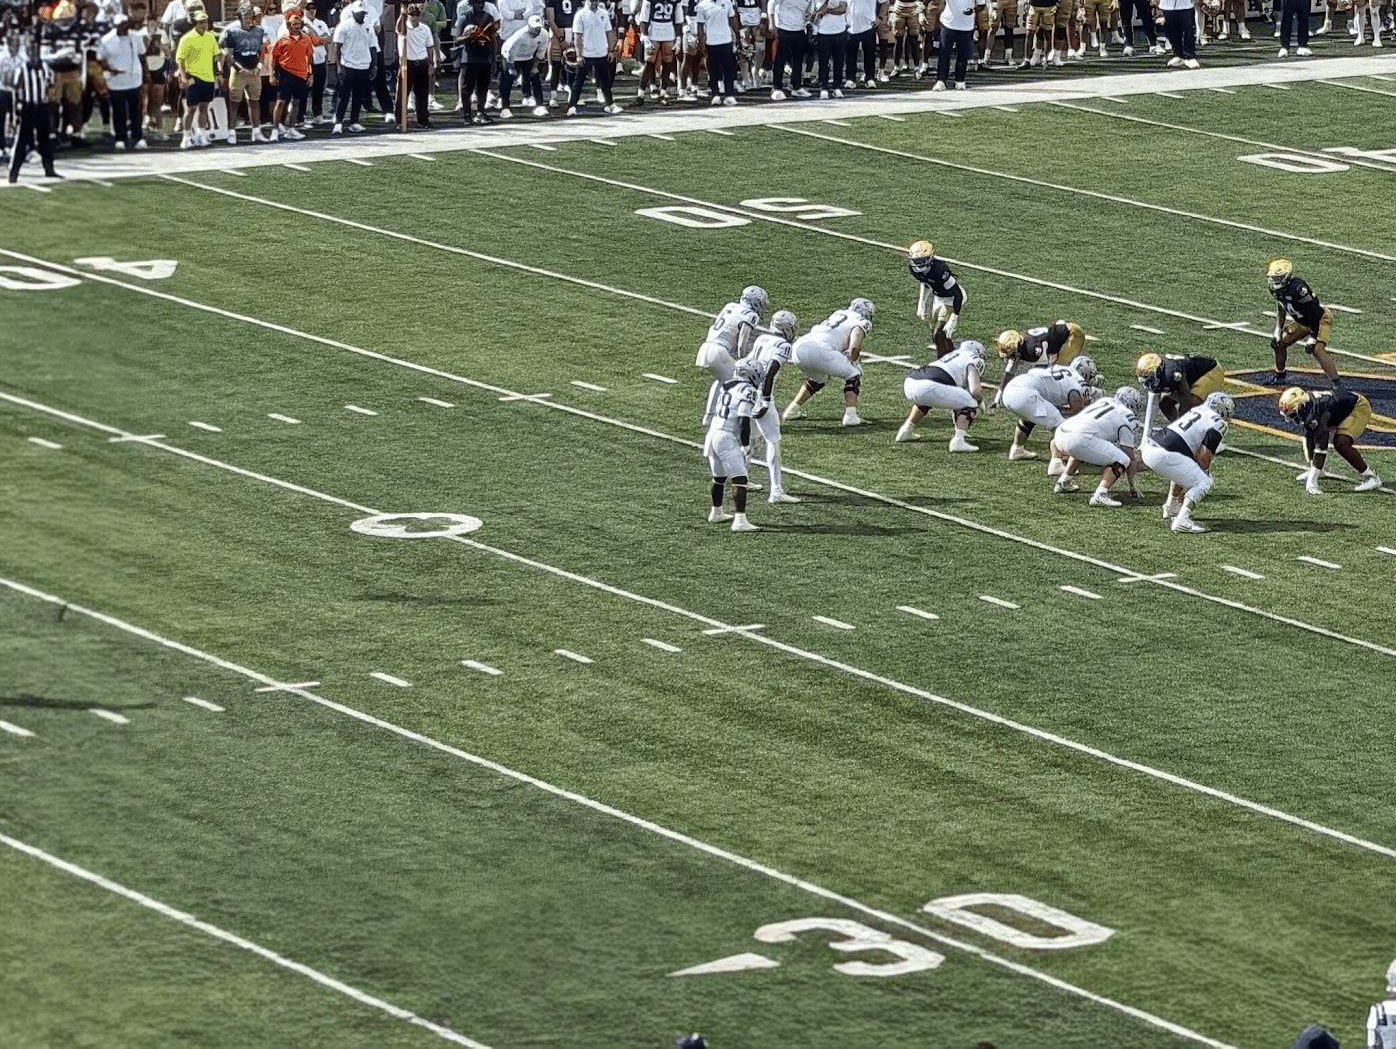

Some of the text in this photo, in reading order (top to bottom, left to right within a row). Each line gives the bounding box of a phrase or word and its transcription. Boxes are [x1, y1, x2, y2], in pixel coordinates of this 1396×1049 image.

[561, 0, 572, 14] 9
[653, 3, 674, 20] 29
[634, 197, 862, 229] 50
[754, 892, 1116, 976] 30
